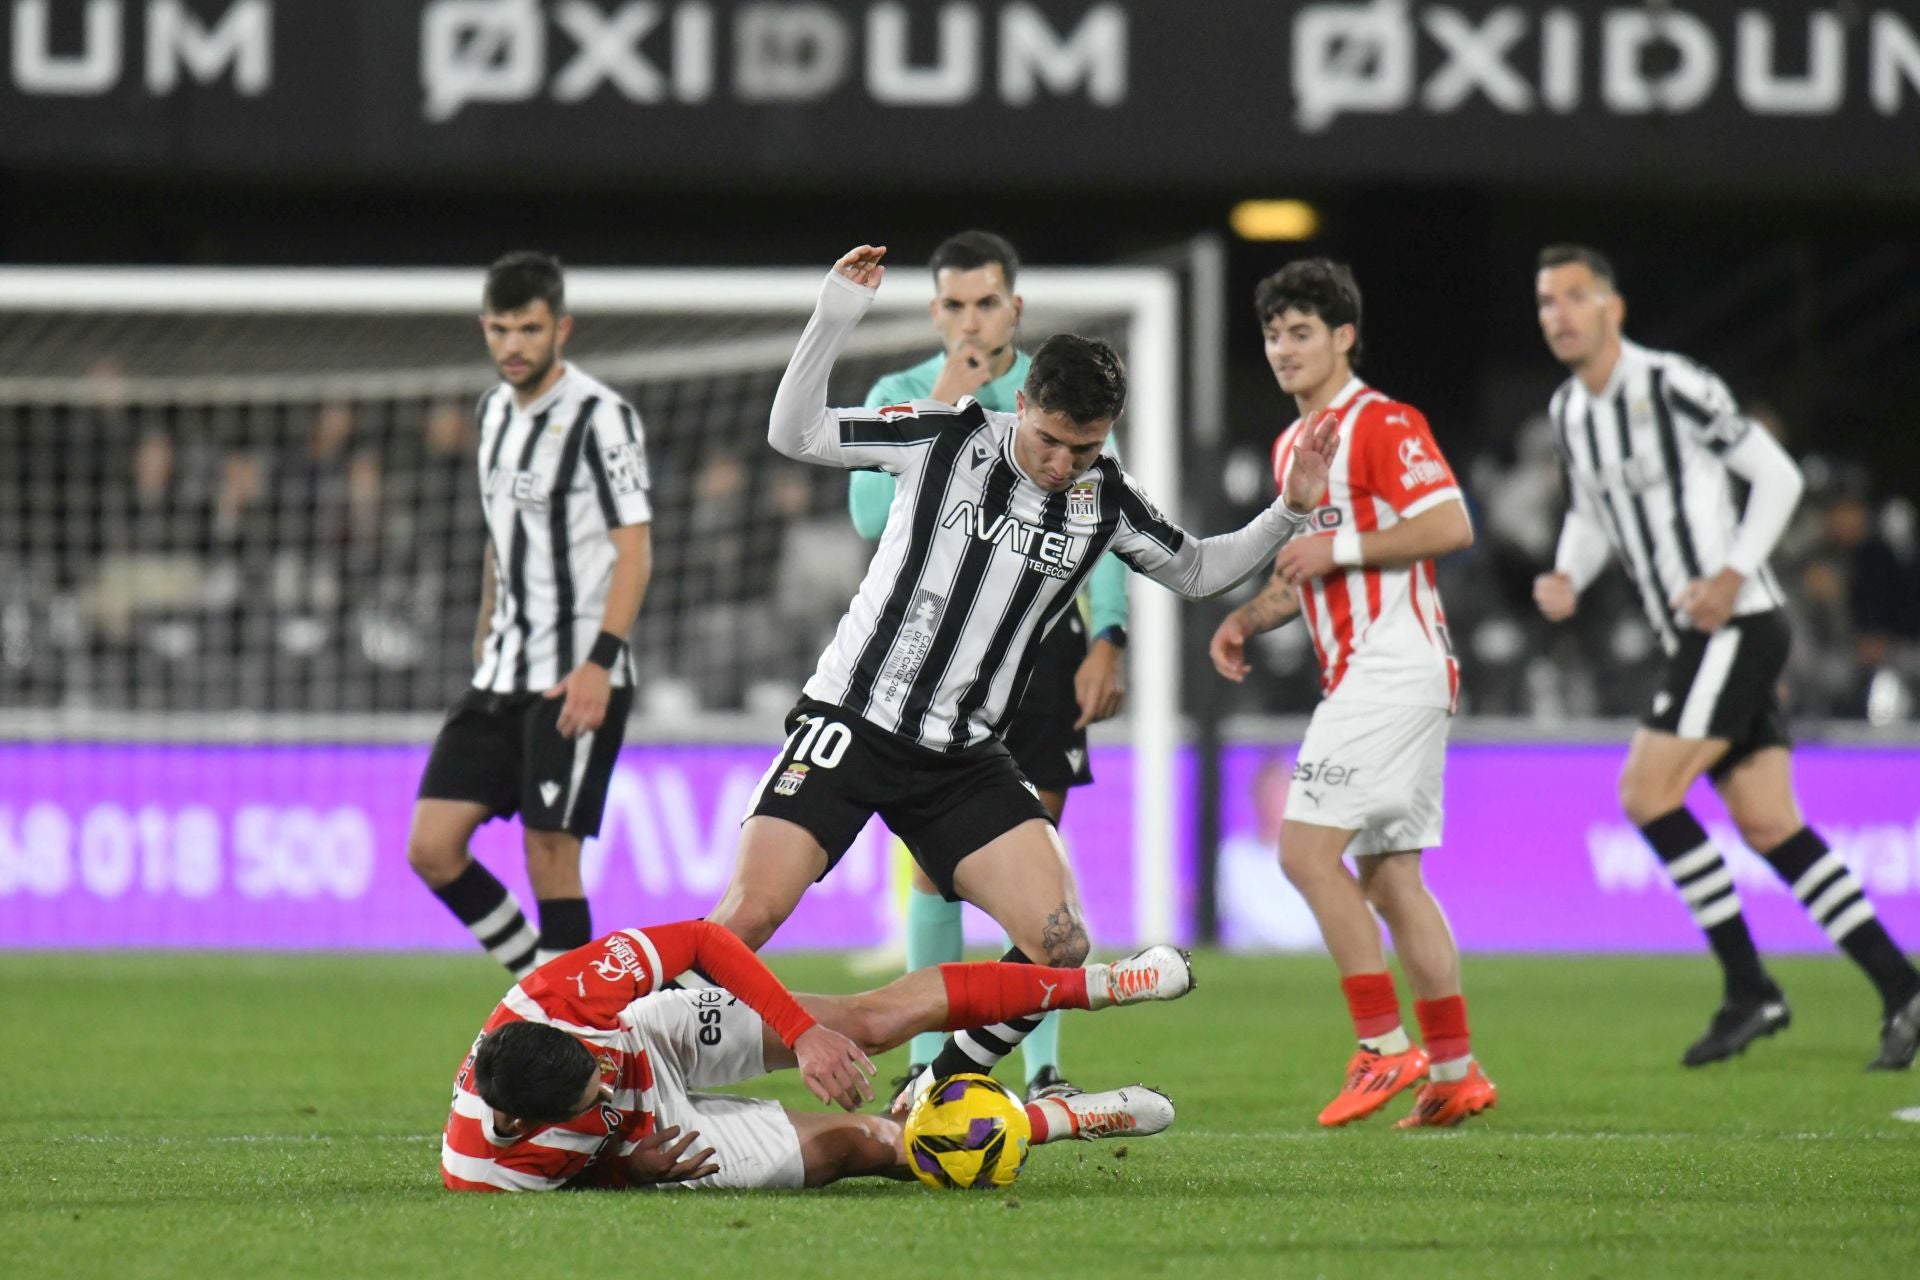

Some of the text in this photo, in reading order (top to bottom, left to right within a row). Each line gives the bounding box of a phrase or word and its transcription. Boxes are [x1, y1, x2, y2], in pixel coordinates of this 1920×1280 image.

[941, 500, 1076, 568] AVATEL
[1029, 559, 1071, 580] TELECOM
[896, 656, 911, 680] CRUZ
[903, 635, 931, 684] CARAVACA
[885, 680, 898, 703] 2024
[793, 716, 852, 769] 10
[80, 802, 220, 900] 018
[233, 802, 376, 900] 500
[691, 988, 721, 1046] esfe
